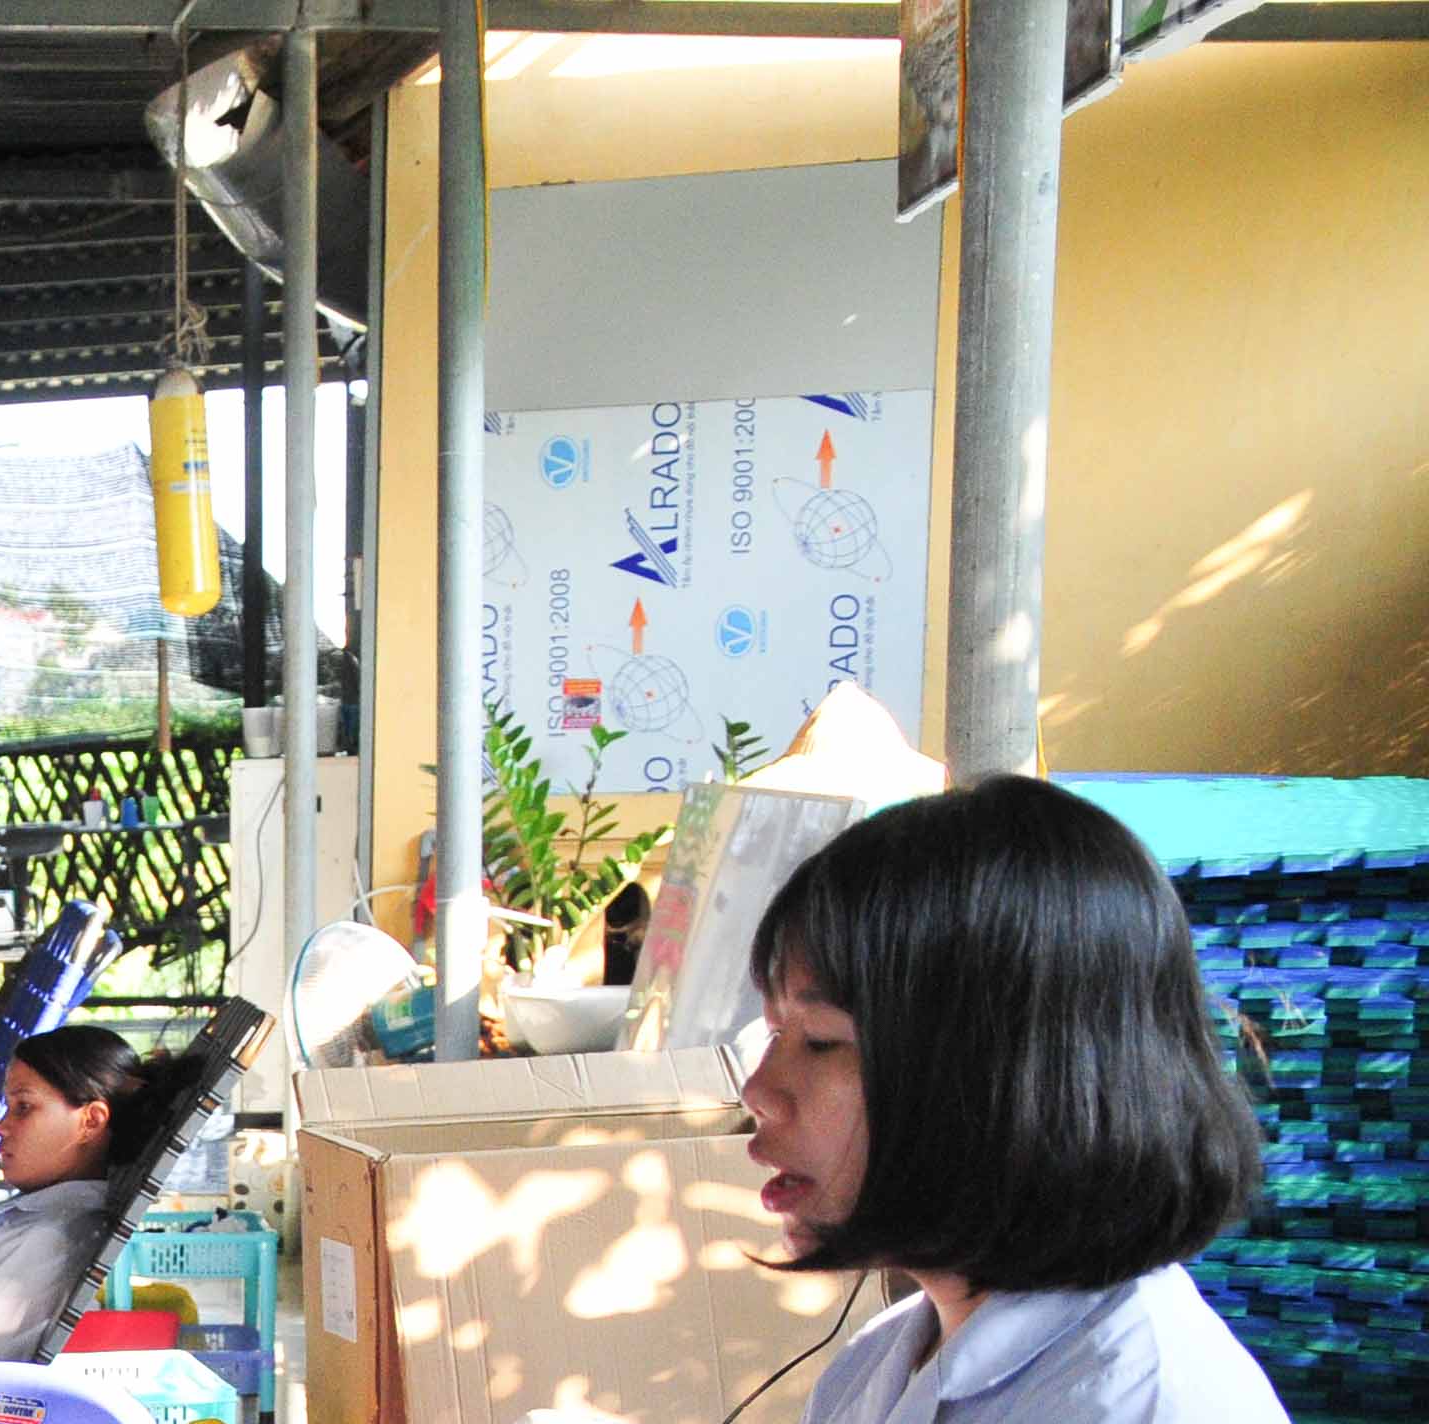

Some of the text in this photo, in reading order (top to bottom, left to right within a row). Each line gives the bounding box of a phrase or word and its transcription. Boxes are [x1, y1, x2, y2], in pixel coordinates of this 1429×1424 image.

[609, 402, 681, 588] ALRADO
[731, 511, 752, 554] ISO
[548, 568, 570, 688] 9001:2008
